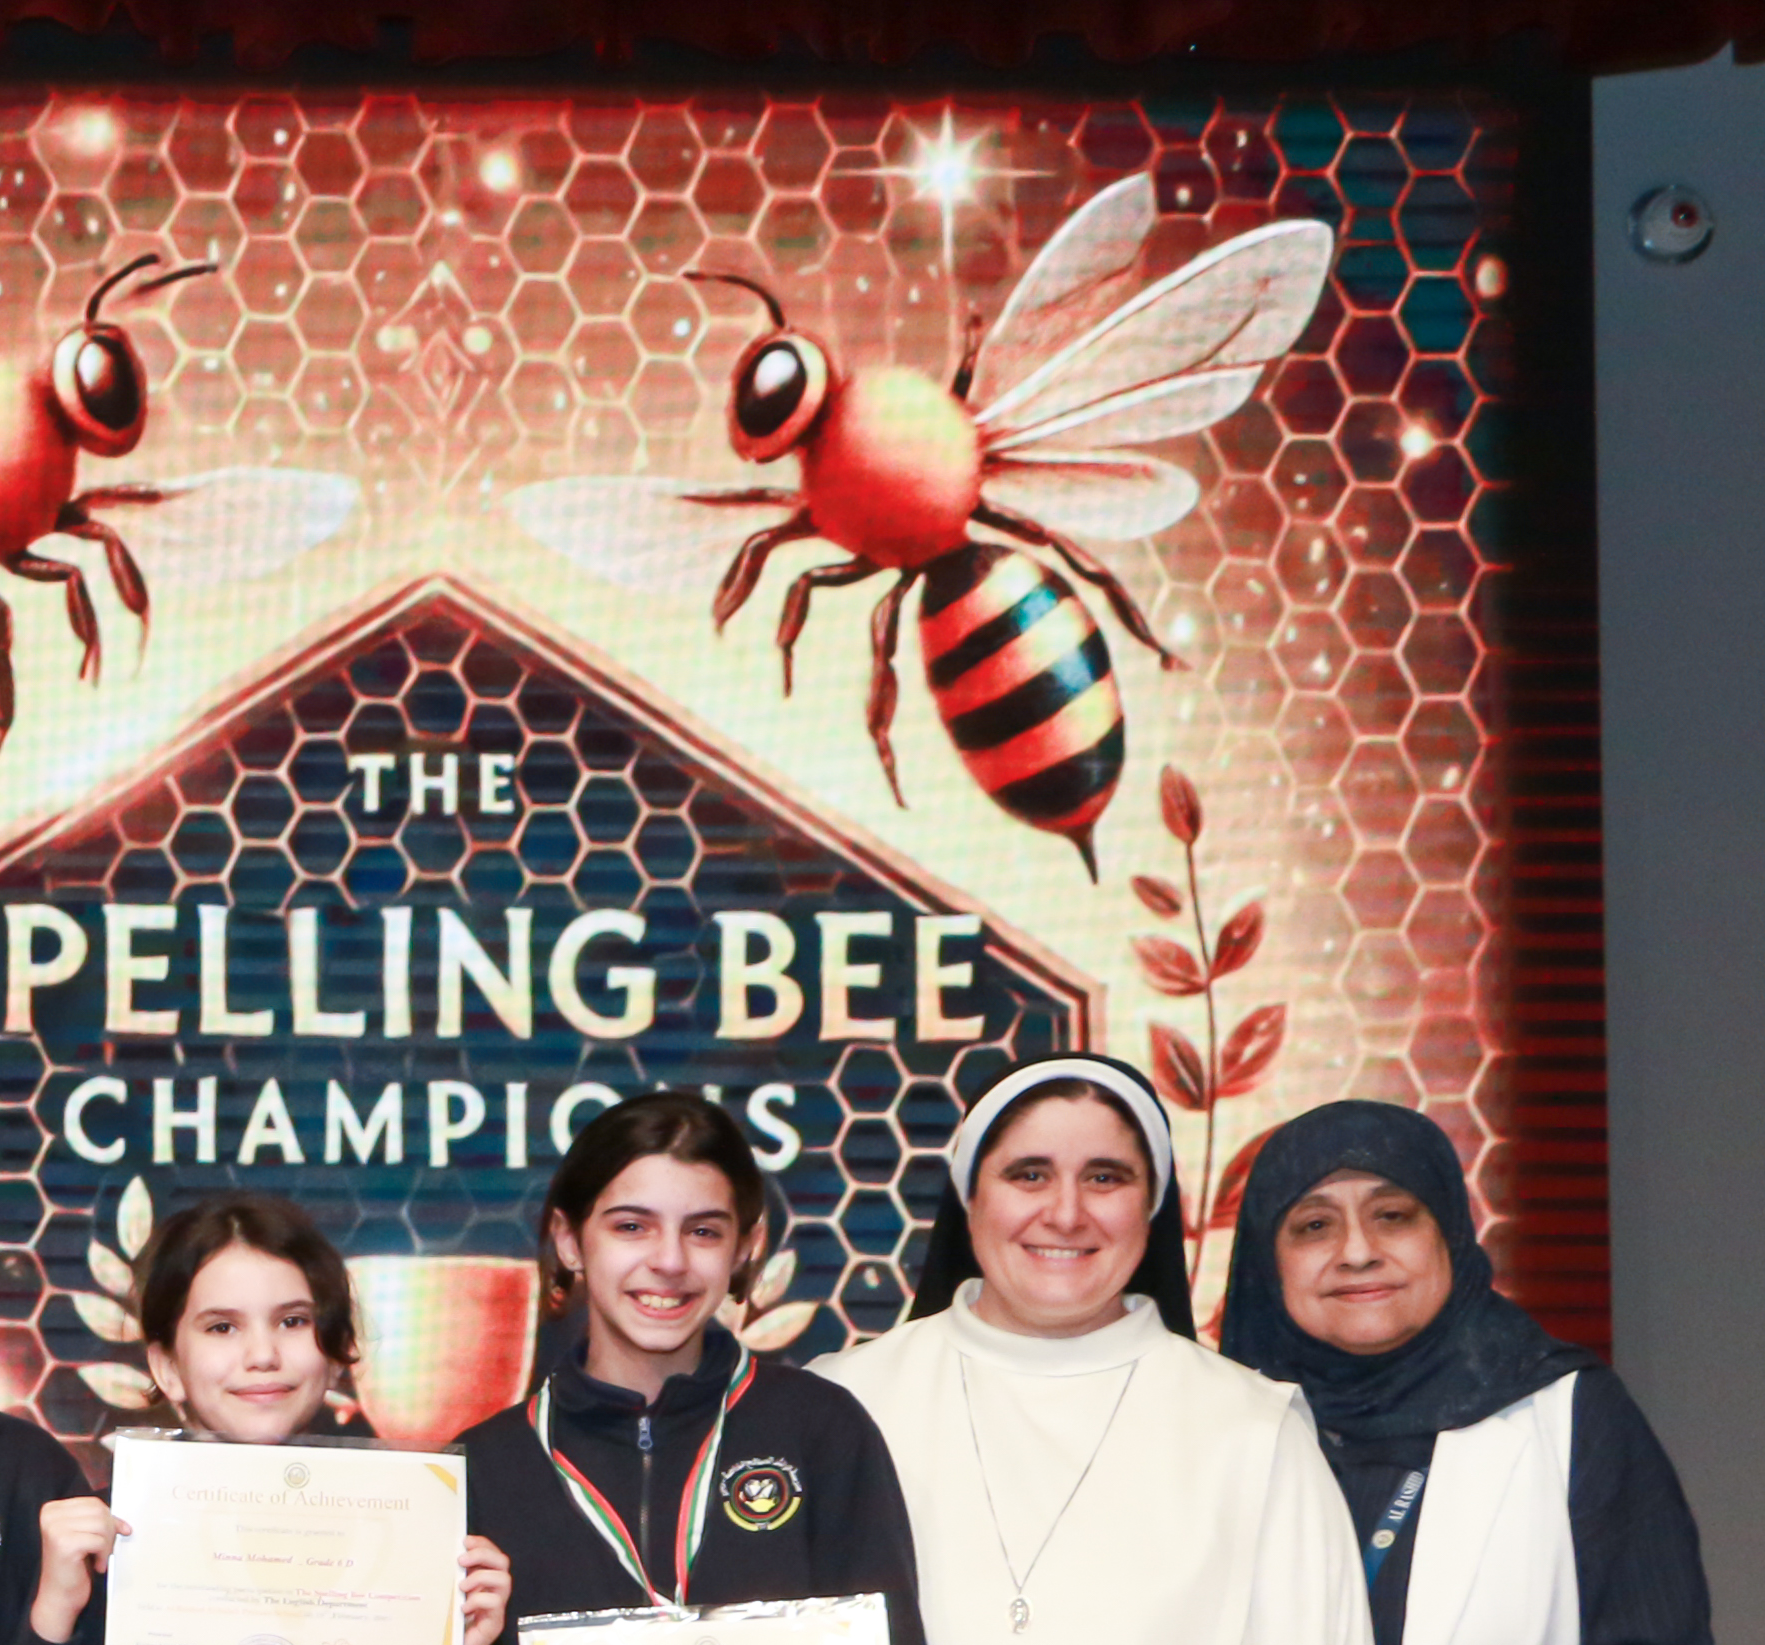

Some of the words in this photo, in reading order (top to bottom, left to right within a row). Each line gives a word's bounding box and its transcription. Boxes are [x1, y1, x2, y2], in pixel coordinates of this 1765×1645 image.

[350, 752, 515, 815] THE
[714, 912, 986, 1040] BEE
[63, 1073, 802, 1172] CHAMPIOS
[172, 1482, 264, 1504] Certificate
[269, 1487, 289, 1505] of
[294, 1489, 409, 1511] Achievement
[306, 1556, 334, 1566] Grade
[265, 1596, 281, 1604] The
[283, 1597, 315, 1607] English
[317, 1598, 367, 1609] Department
